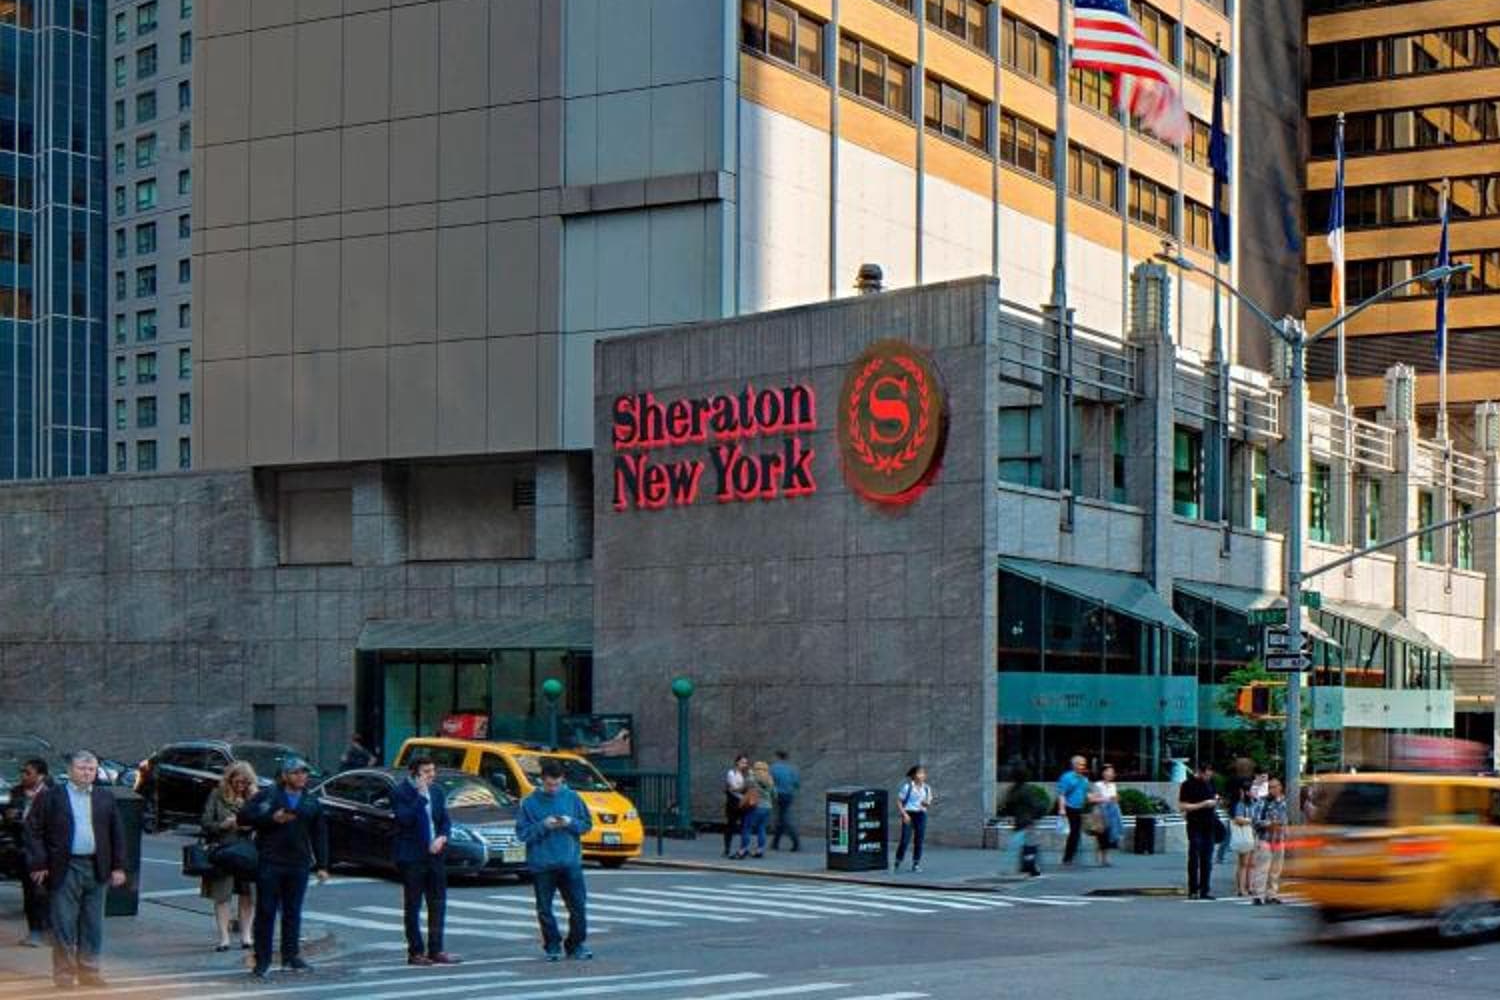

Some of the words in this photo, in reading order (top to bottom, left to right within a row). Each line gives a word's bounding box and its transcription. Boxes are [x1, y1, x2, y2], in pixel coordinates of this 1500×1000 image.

[612, 382, 816, 449] Sheraton
[869, 376, 911, 444] S
[613, 453, 704, 510] New
[709, 438, 816, 503] York
